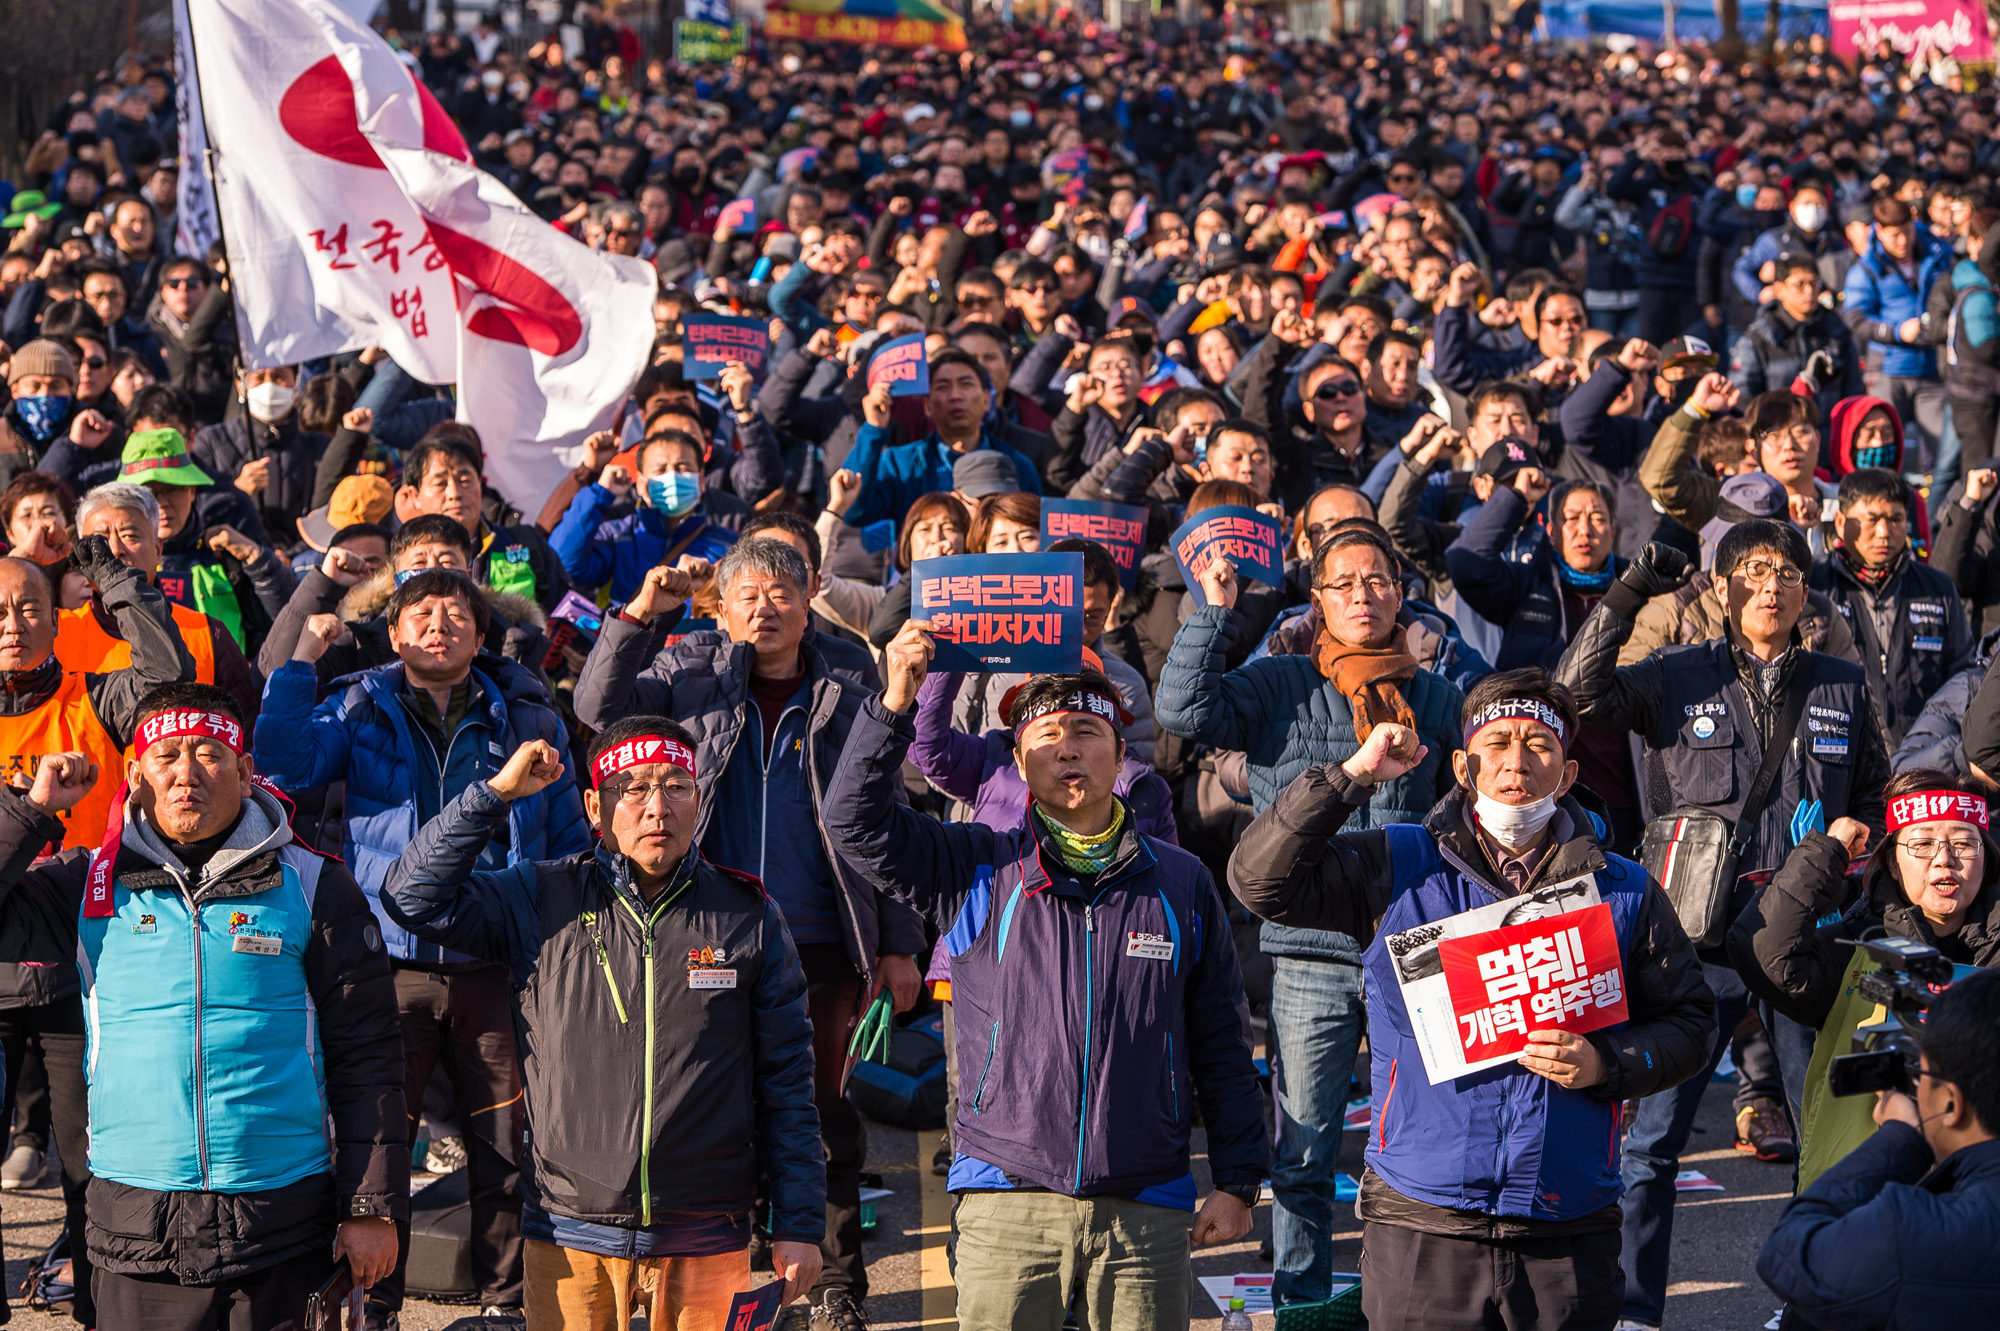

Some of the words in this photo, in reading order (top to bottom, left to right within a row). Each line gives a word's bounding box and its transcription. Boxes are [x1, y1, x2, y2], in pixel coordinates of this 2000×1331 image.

[1047, 512, 1143, 545] 탄력근로제
[1177, 516, 1276, 567] 탄력근로제
[921, 574, 1074, 608] 탄력근로제
[931, 612, 1062, 645] 확대저지!
[143, 711, 178, 744] 단결
[204, 712, 239, 747] 투쟁
[599, 741, 635, 777] 단결
[662, 739, 694, 772] 투쟁
[1892, 794, 1929, 825] 단결
[1955, 795, 1987, 824] 투쟁
[1476, 926, 1588, 1003] 멈춰!
[1459, 999, 1528, 1049] 개혁
[1530, 968, 1623, 1024] 역주행
